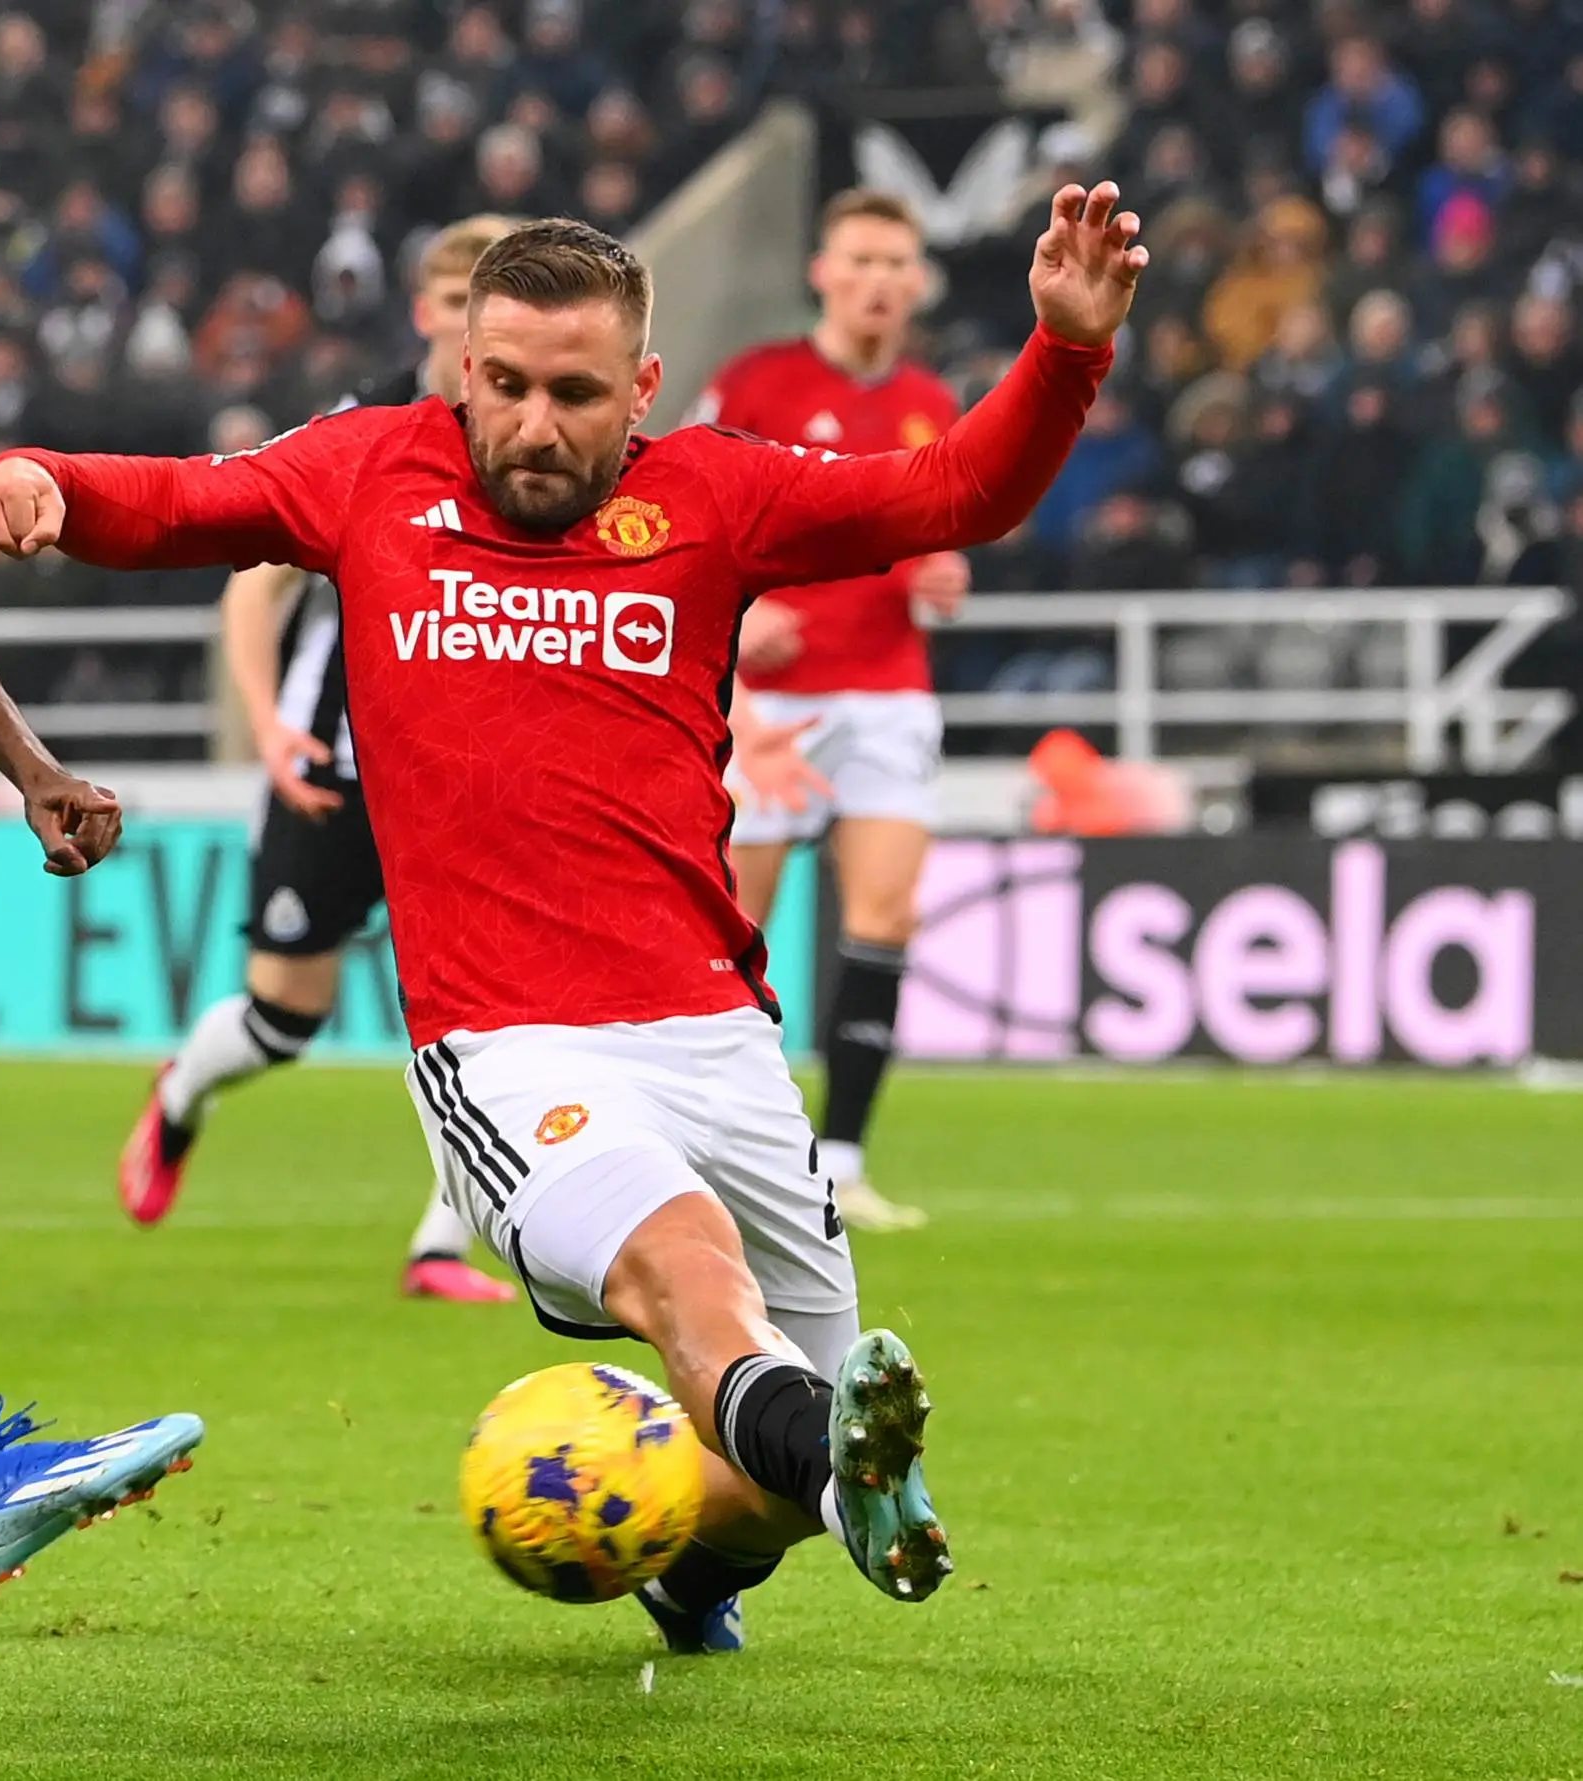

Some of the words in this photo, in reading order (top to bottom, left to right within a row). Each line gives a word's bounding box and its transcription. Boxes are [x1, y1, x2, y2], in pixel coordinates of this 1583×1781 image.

[429, 569, 597, 624] Team
[389, 609, 596, 666] Viewer
[1084, 838, 1535, 1065] sela
